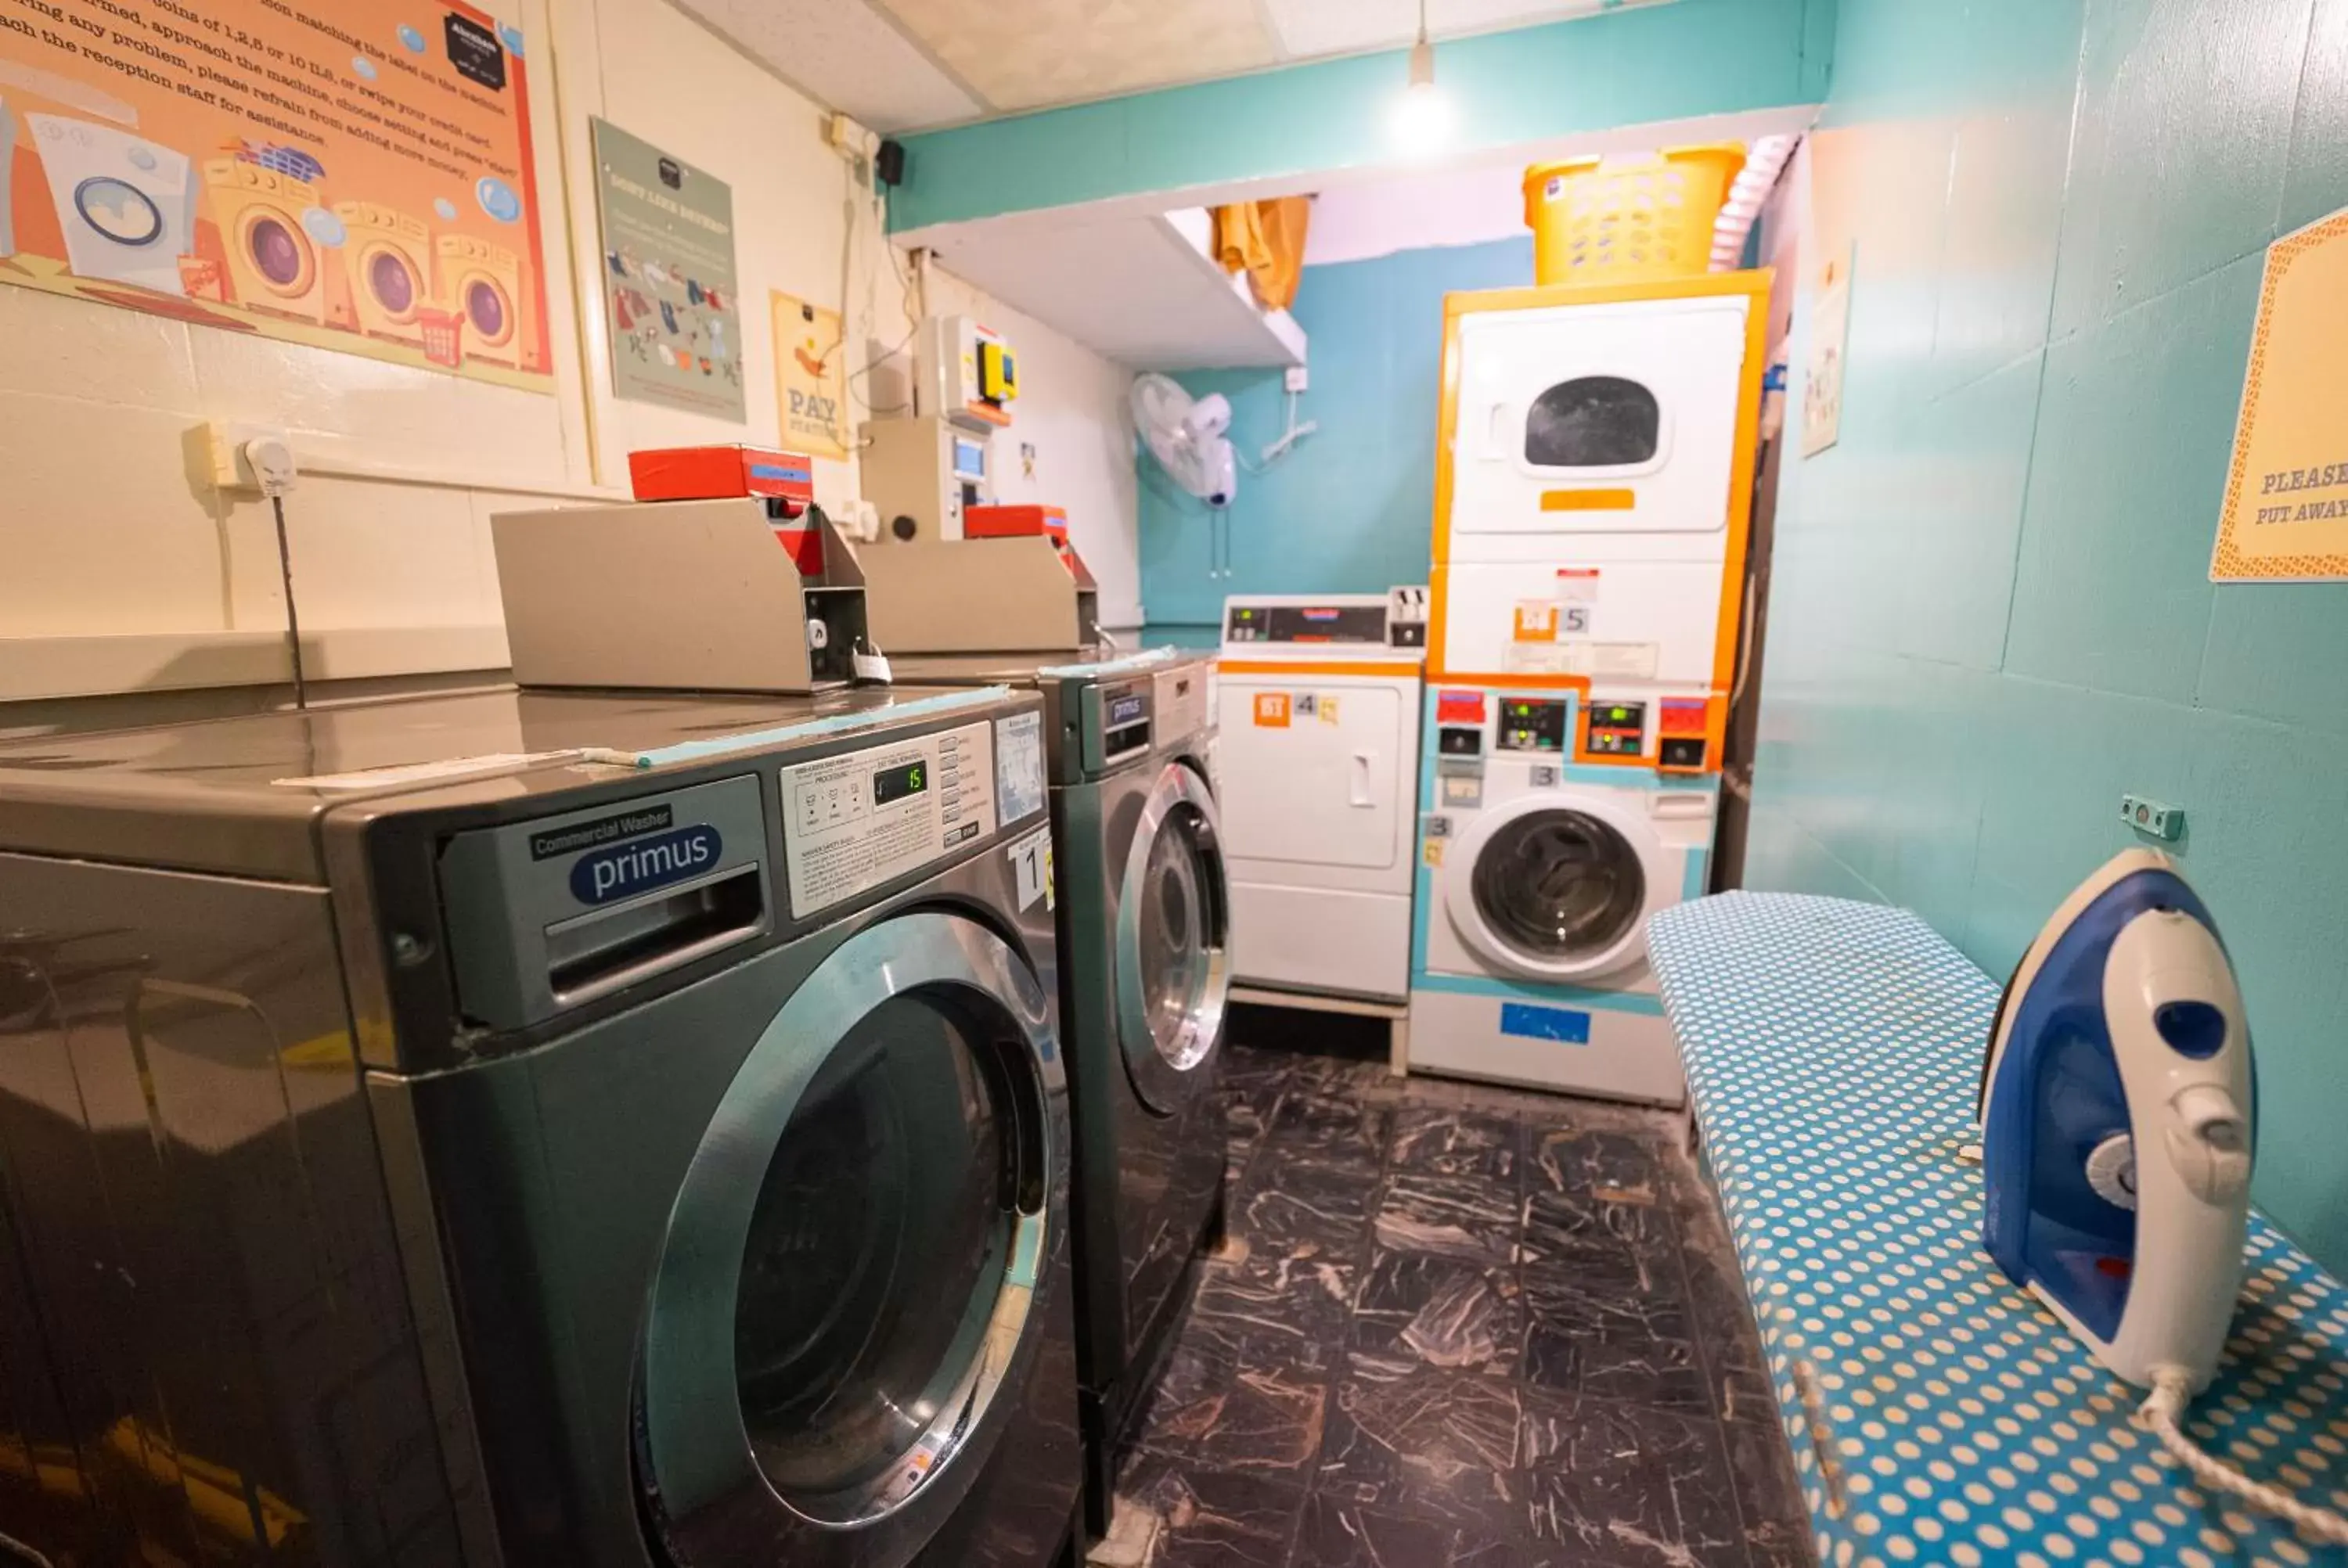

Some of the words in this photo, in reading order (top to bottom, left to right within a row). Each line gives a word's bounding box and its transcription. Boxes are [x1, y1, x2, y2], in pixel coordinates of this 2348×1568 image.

[151, 21, 233, 63] approach
[236, 55, 262, 74] the
[203, 19, 220, 33] of
[267, 46, 284, 60] or
[289, 52, 306, 69] 10
[296, 12, 362, 52] matching
[364, 42, 386, 61] the
[41, 29, 77, 52] the
[81, 46, 172, 89] reception
[177, 82, 216, 106] staff
[220, 97, 243, 115] for
[69, 15, 105, 38] any
[111, 31, 193, 74] problem,
[196, 65, 249, 94] please
[253, 86, 307, 116] refrain
[309, 108, 343, 131] from
[346, 124, 391, 151] adding
[787, 387, 835, 423] PAY
[2261, 462, 2348, 494] PLEASE
[2256, 505, 2292, 525] PUT
[1567, 609, 1584, 631] 5
[1298, 695, 1313, 714] 4
[909, 768, 922, 789] 15
[1540, 766, 1554, 786] 3
[535, 822, 619, 854] Commercial
[620, 811, 670, 833] Washer
[1431, 818, 1447, 836] 3
[592, 836, 708, 899] primus
[1026, 847, 1038, 890] 1
